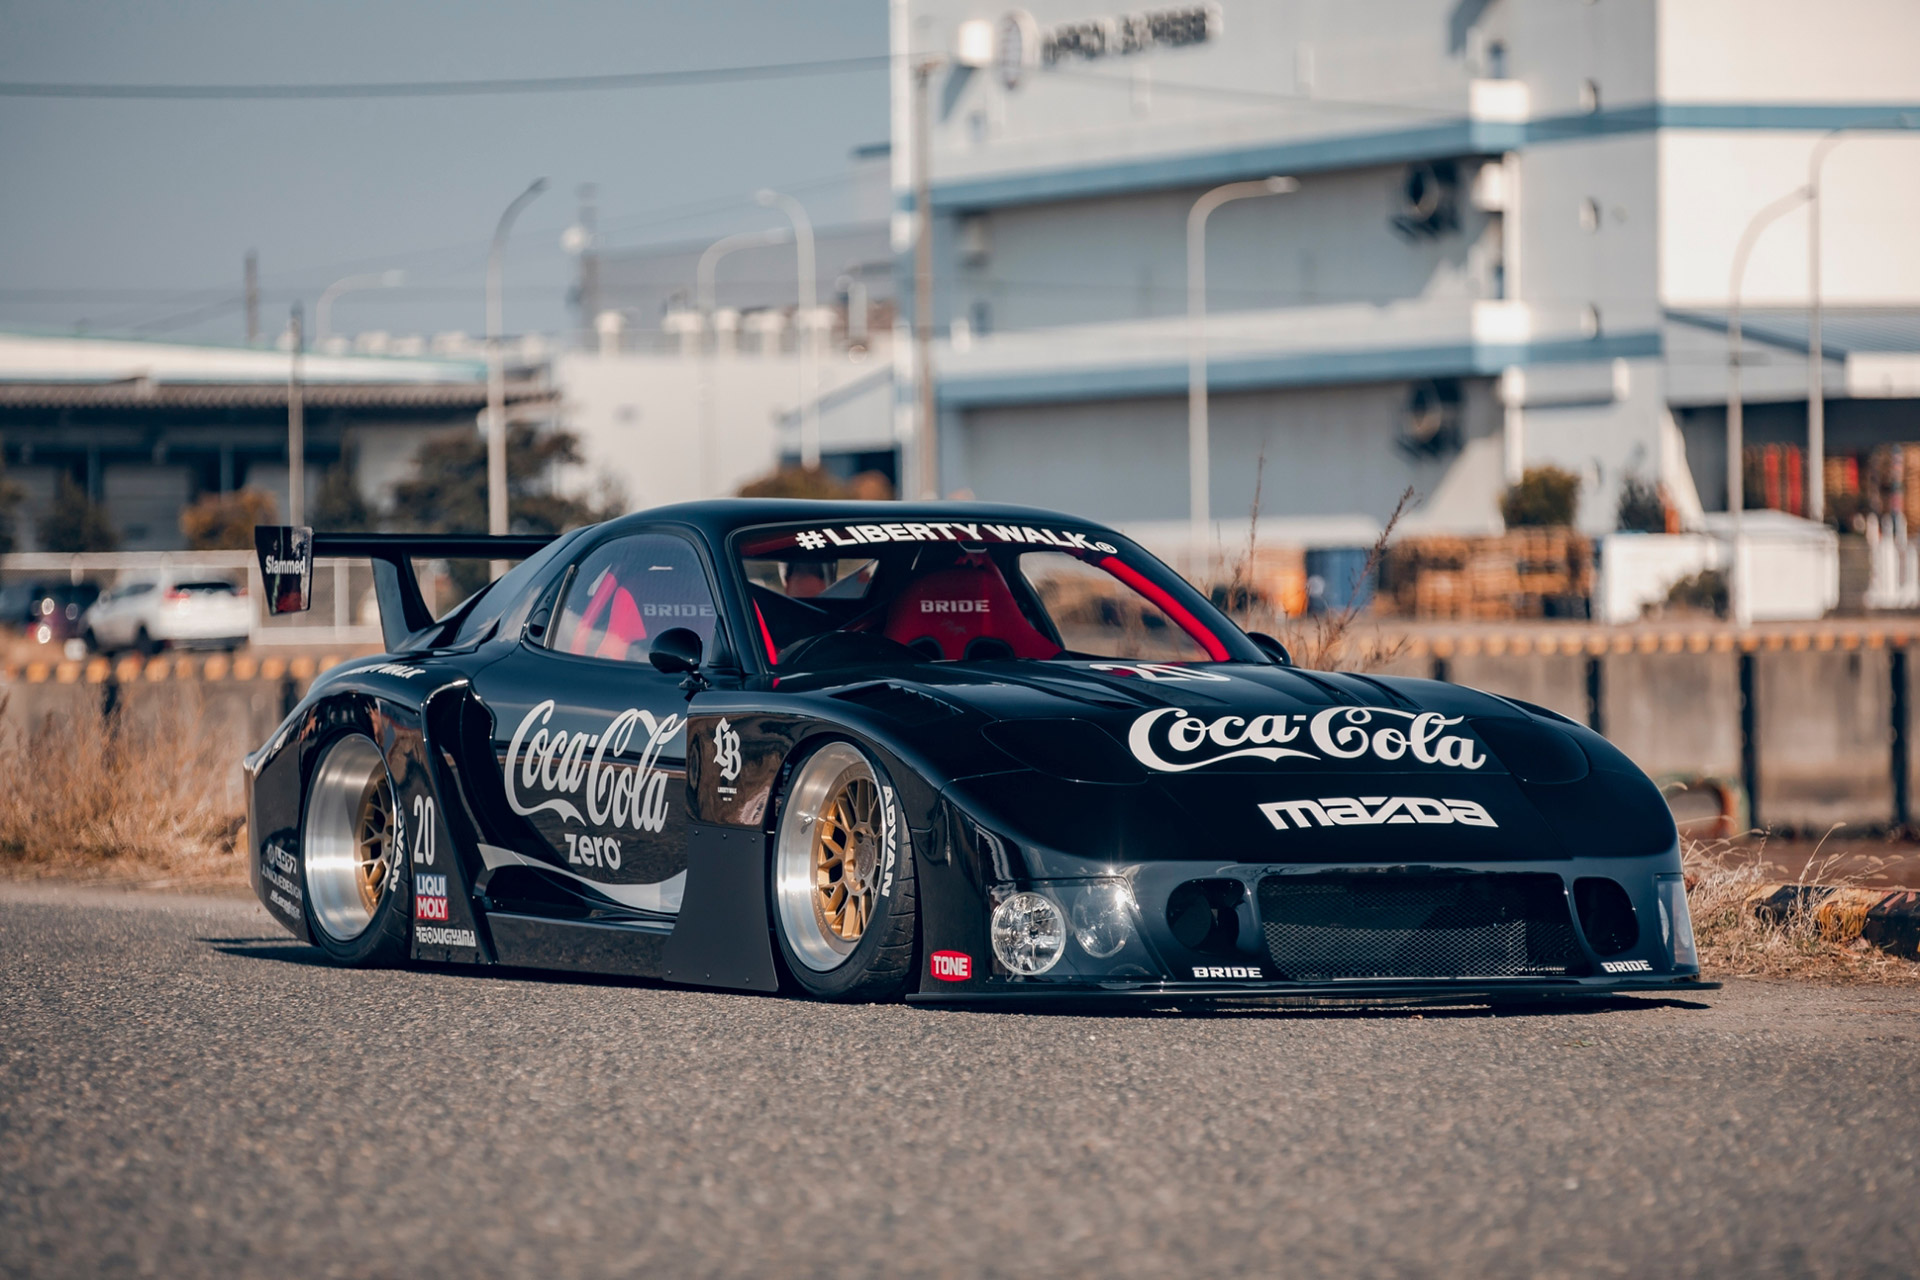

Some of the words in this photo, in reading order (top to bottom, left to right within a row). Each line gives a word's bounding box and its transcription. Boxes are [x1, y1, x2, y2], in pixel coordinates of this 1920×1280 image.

[795, 523, 980, 550] #LIBERTY
[265, 554, 306, 575] Slammed
[643, 603, 714, 617] BRIDE
[920, 599, 991, 613] BRIDE
[1089, 663, 1231, 682] 20
[1128, 706, 1486, 772] Coca-Cola
[504, 699, 687, 834] Coca-Cola
[413, 794, 435, 866] 20
[564, 833, 621, 871] zero
[881, 785, 897, 898] ADVAN
[416, 875, 446, 896] LIQUI
[417, 898, 447, 918] MOLY
[933, 956, 968, 976] TONE
[1192, 967, 1263, 978] BRIDE
[1601, 960, 1653, 973] BRIDE
